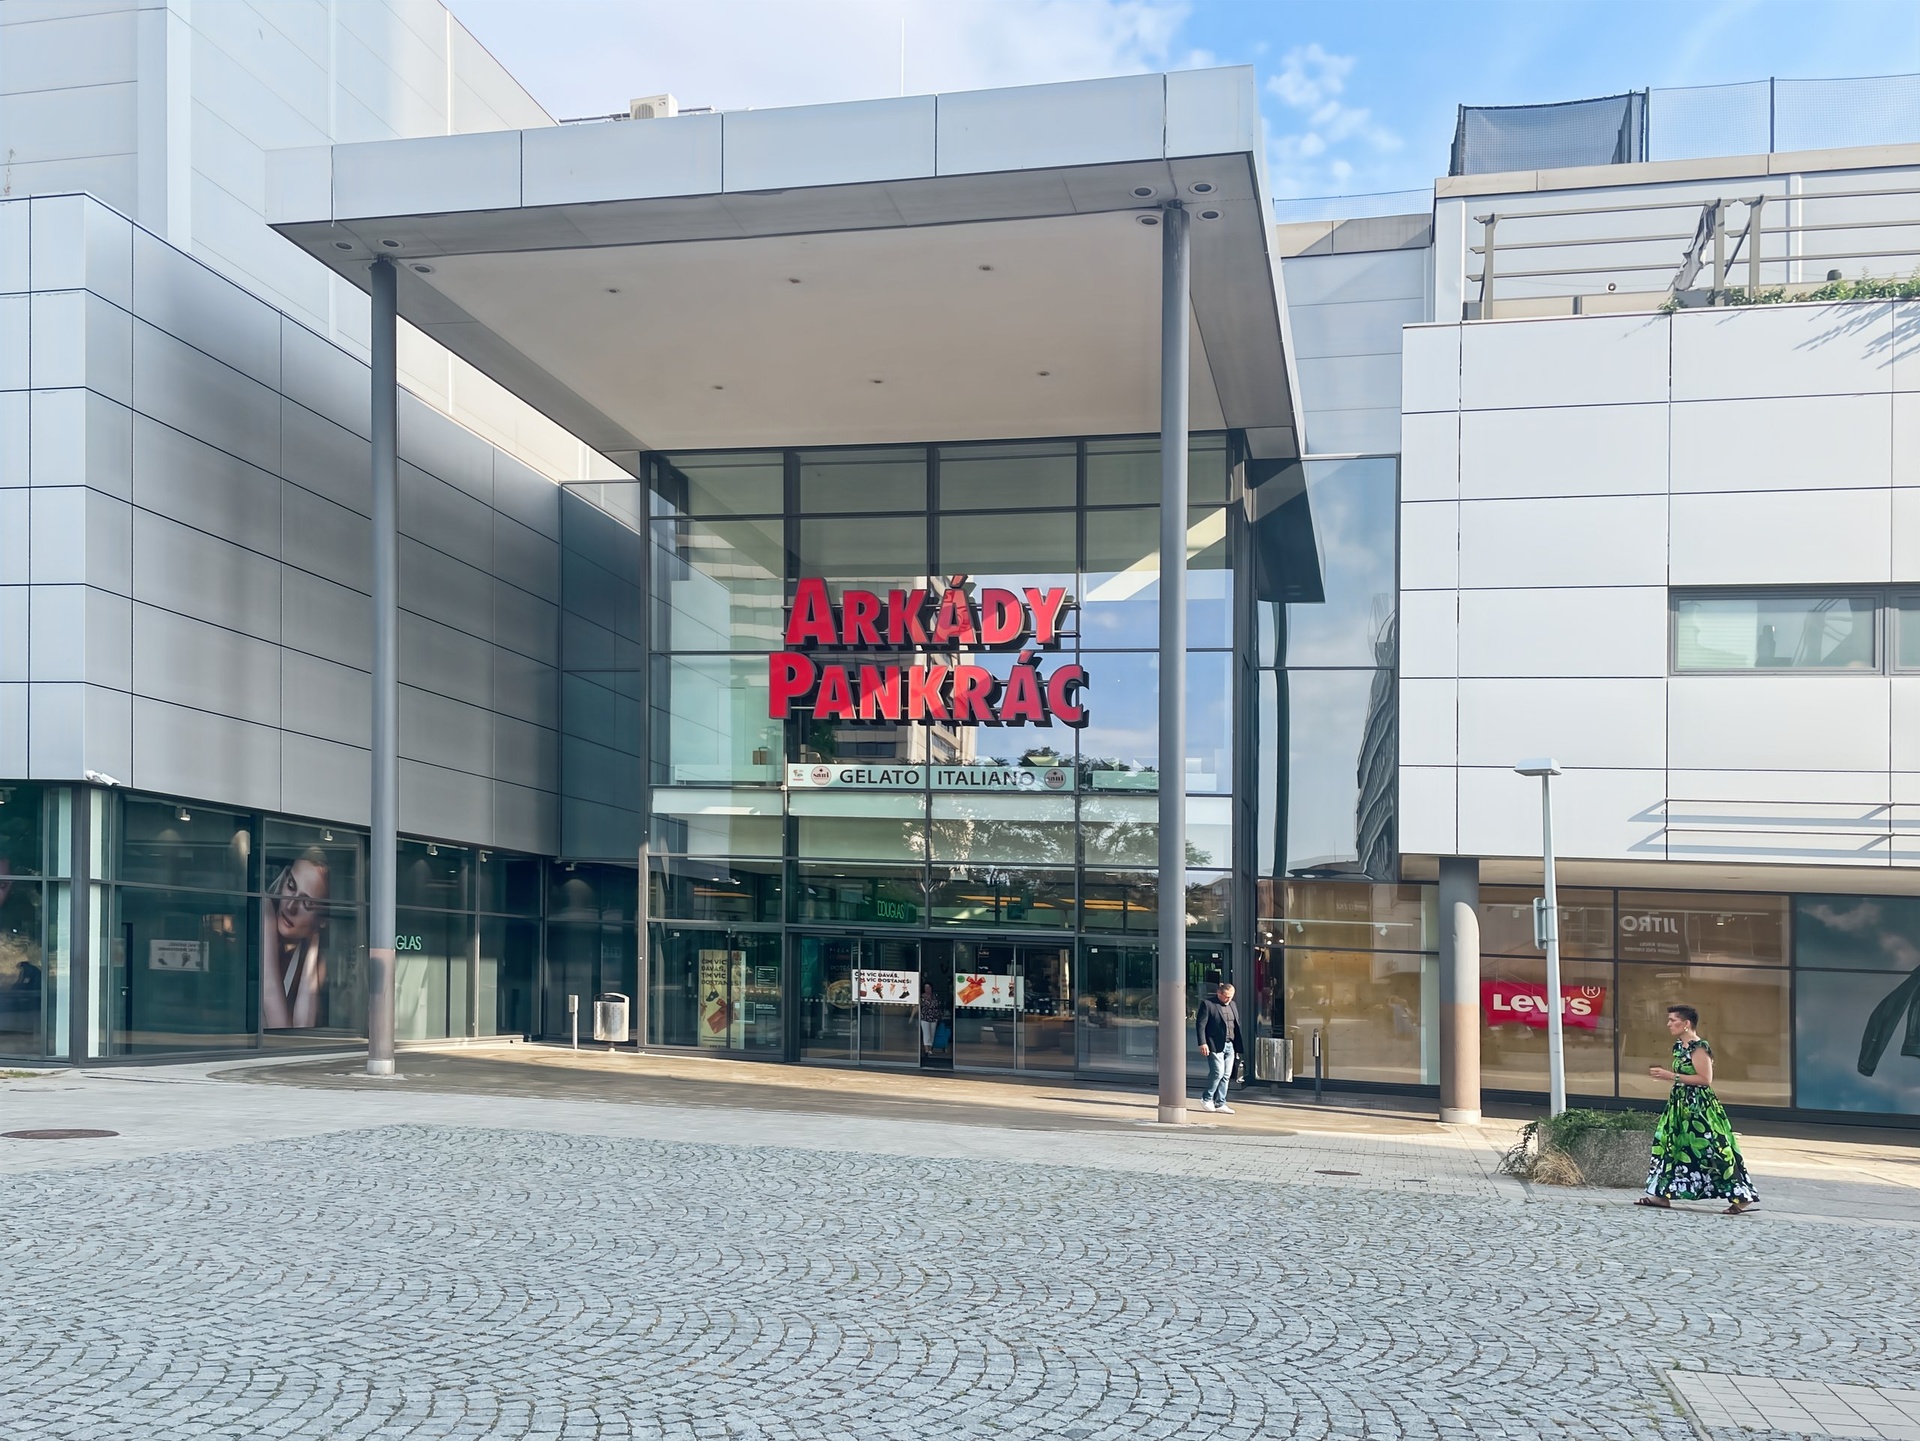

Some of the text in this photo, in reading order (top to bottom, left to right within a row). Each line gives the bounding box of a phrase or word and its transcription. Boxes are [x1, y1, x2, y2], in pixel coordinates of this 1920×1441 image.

[785, 574, 1068, 646] ARKÁDY
[768, 650, 1086, 723] PANKRÁC
[839, 769, 1035, 786] GELATO ITALIANO
[395, 935, 422, 951] GLAS
